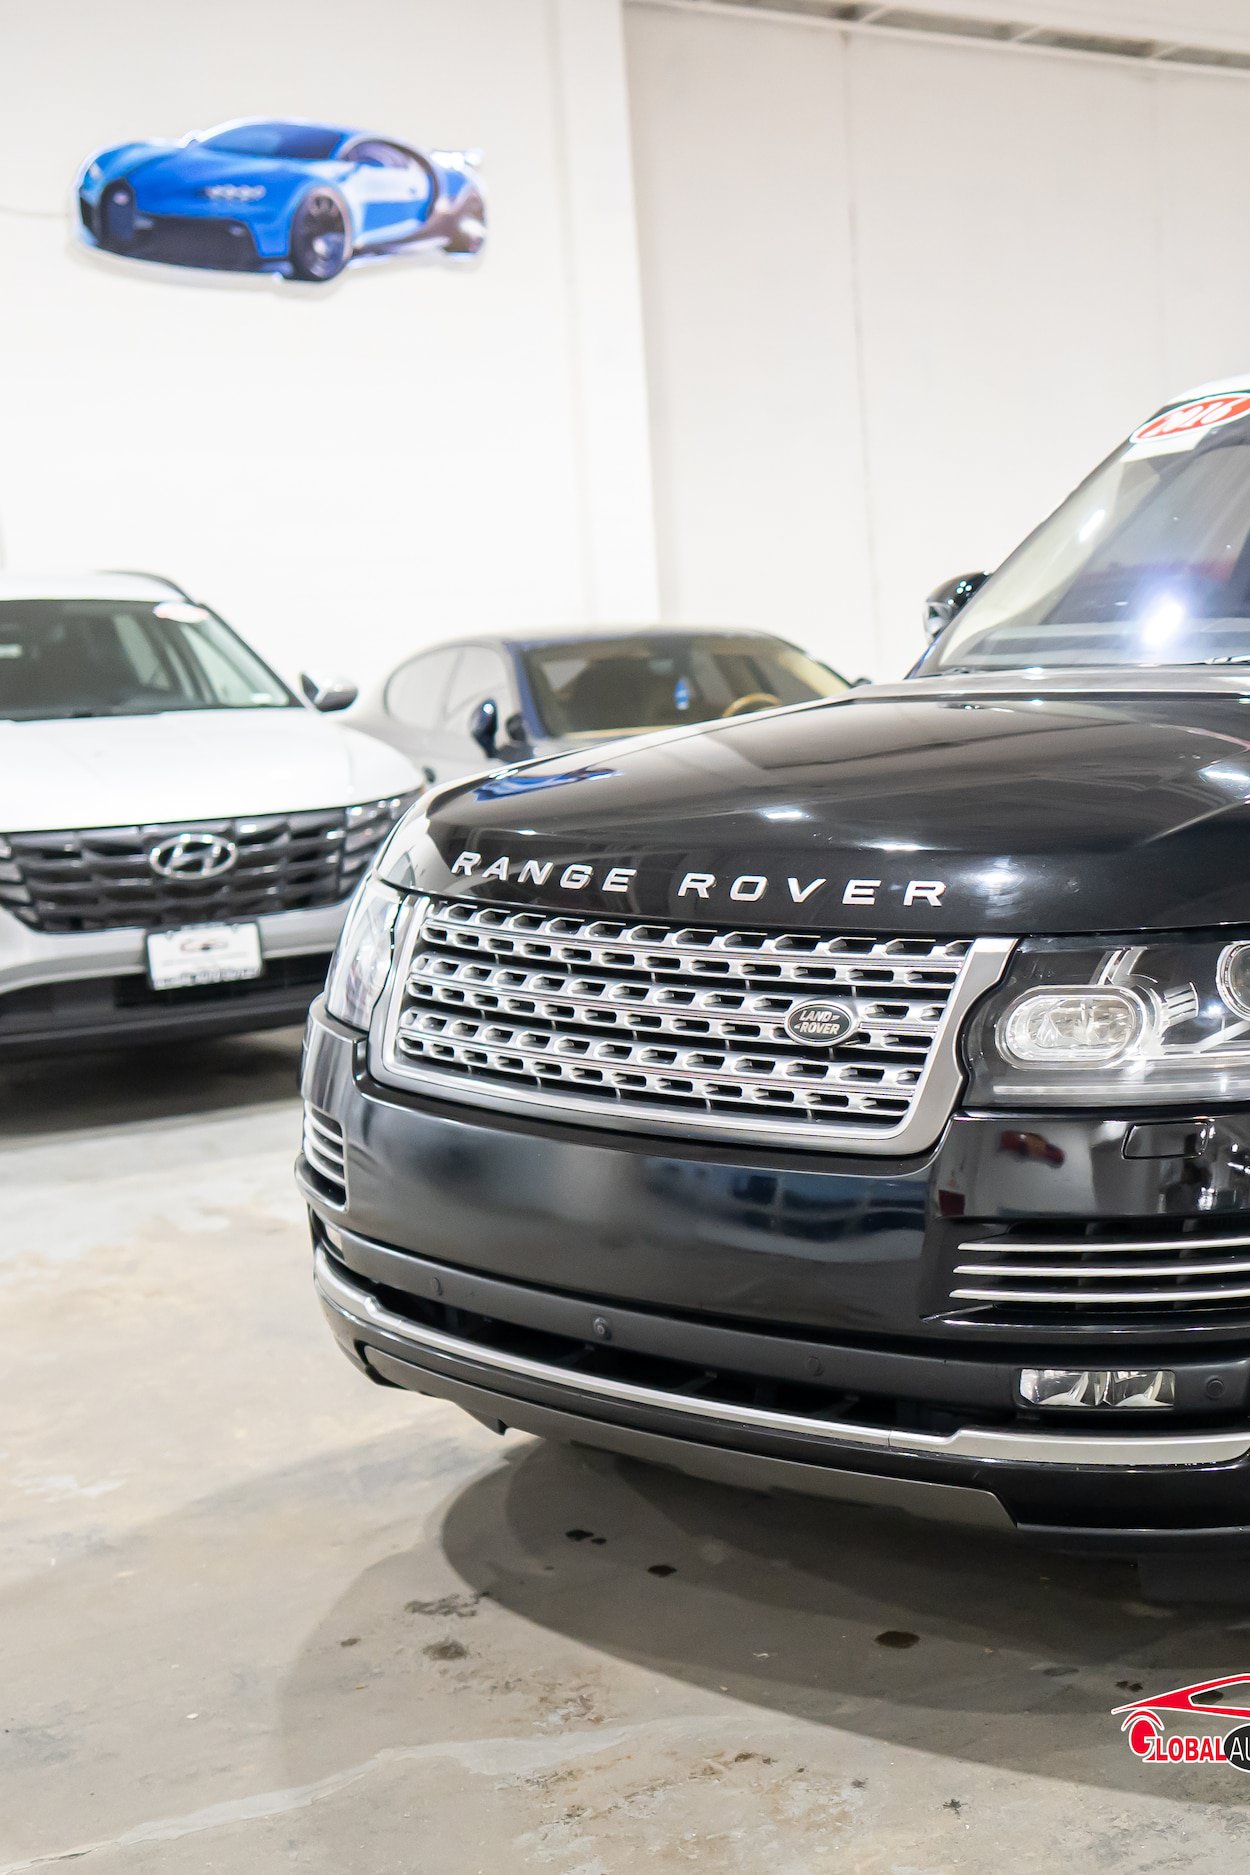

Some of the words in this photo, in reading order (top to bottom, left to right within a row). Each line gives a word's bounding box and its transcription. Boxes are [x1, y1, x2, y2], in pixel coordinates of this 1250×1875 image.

[451, 850, 637, 893] RANGE
[678, 871, 948, 908] ROVER
[799, 1010, 833, 1023] LAND
[799, 1021, 840, 1035] ROVER
